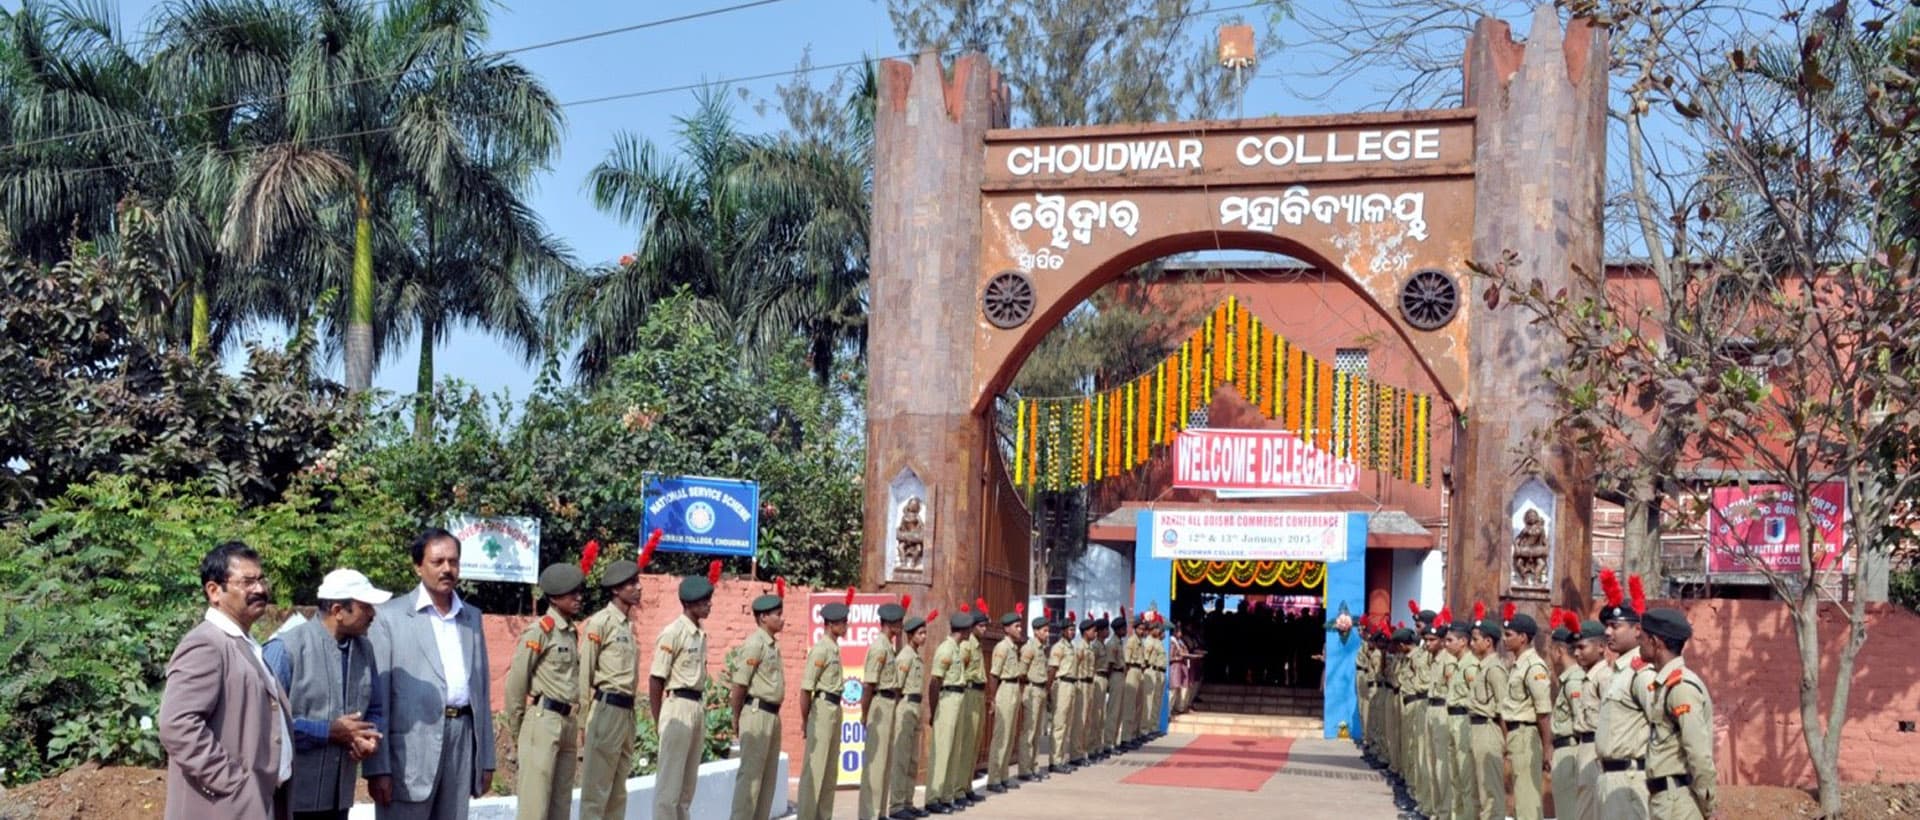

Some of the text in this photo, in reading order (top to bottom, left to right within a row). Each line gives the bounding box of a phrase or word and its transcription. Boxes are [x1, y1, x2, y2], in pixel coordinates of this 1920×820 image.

[1006, 129, 1441, 176] CHOUDWAR COLLEGE
[1178, 436, 1256, 483] WELCOME
[649, 488, 688, 515] NATIONAL
[688, 486, 722, 501] SERVICE
[1810, 496, 1838, 515] ORPS
[1188, 515, 1201, 527] ALL
[1236, 515, 1284, 528] COMMERCE
[1286, 515, 1339, 528] CONFERENCE
[1241, 534, 1282, 545] January
